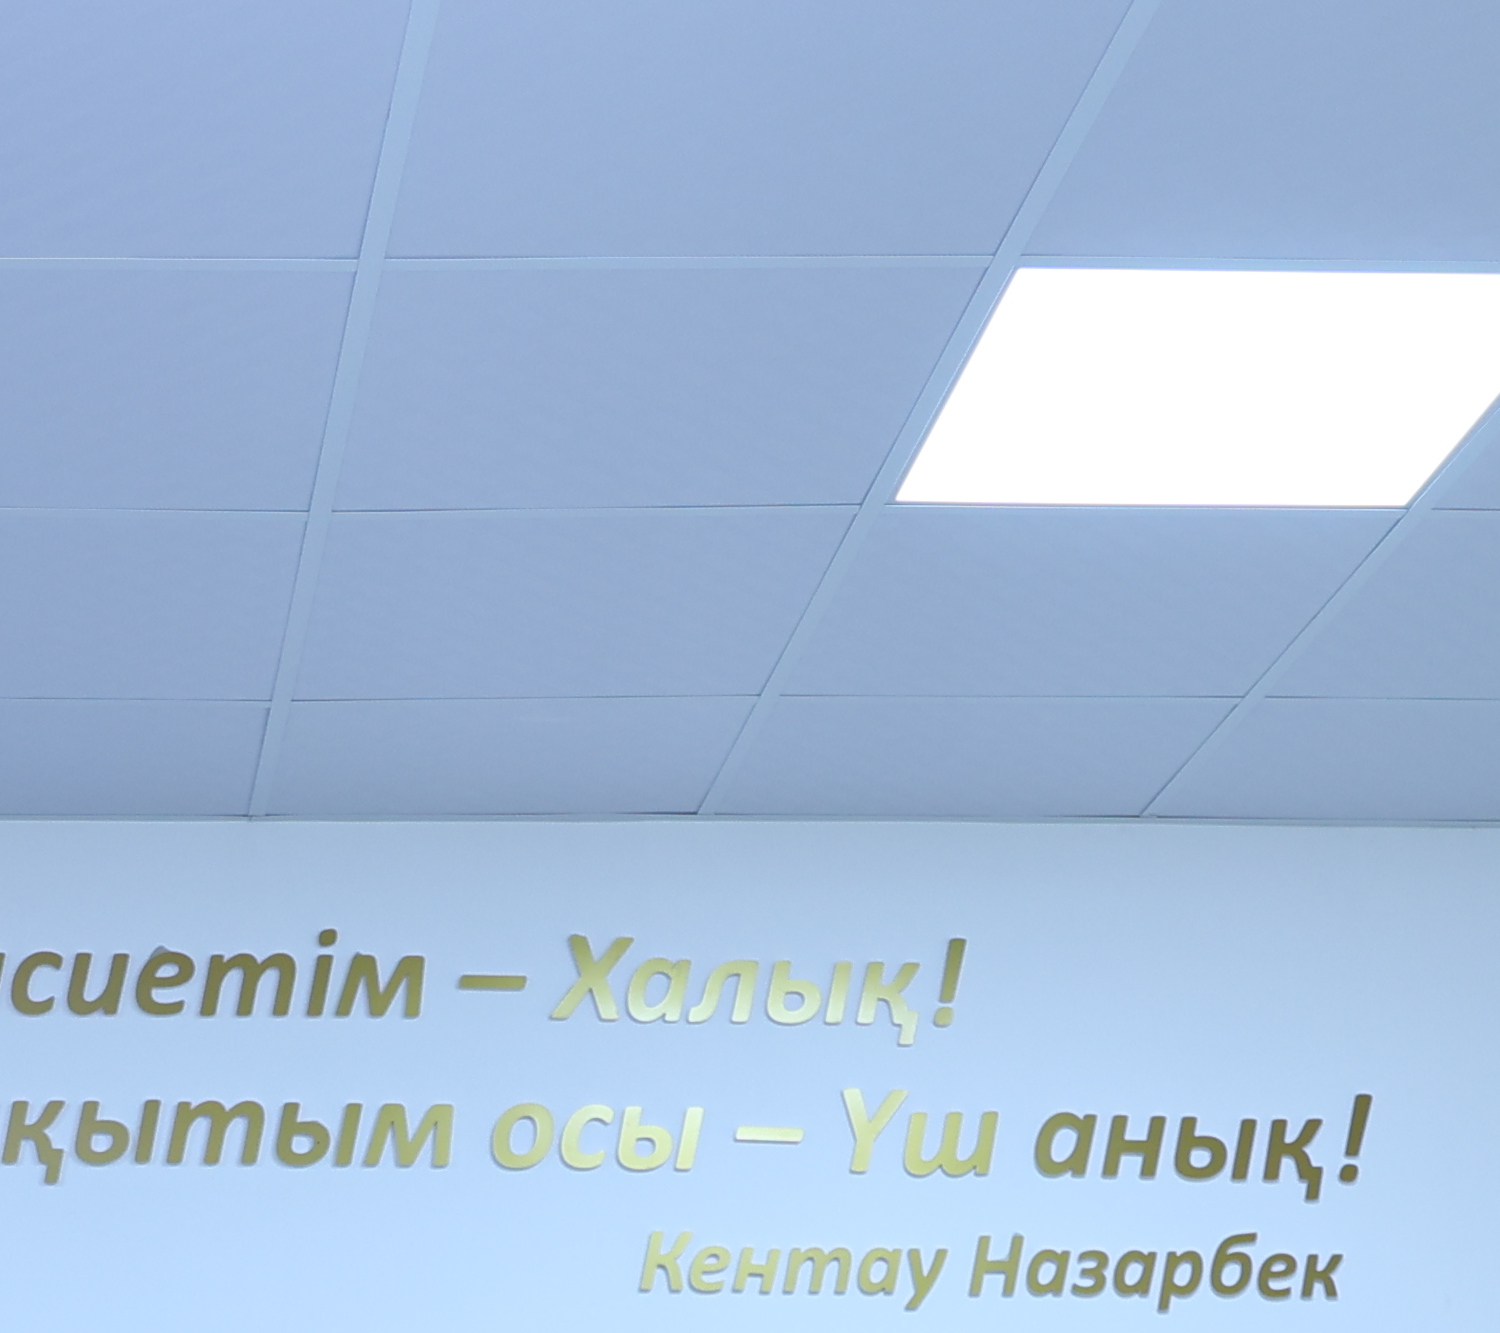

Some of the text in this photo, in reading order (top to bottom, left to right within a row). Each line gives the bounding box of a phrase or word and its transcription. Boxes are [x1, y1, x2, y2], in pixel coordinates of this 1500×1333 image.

[549, 933, 967, 1046] Халық!
[490, 1102, 704, 1172] осы
[841, 1087, 998, 1177] Үш
[1034, 1093, 1373, 1201] анық!
[639, 1230, 1343, 1313] Кентау Назарбек
